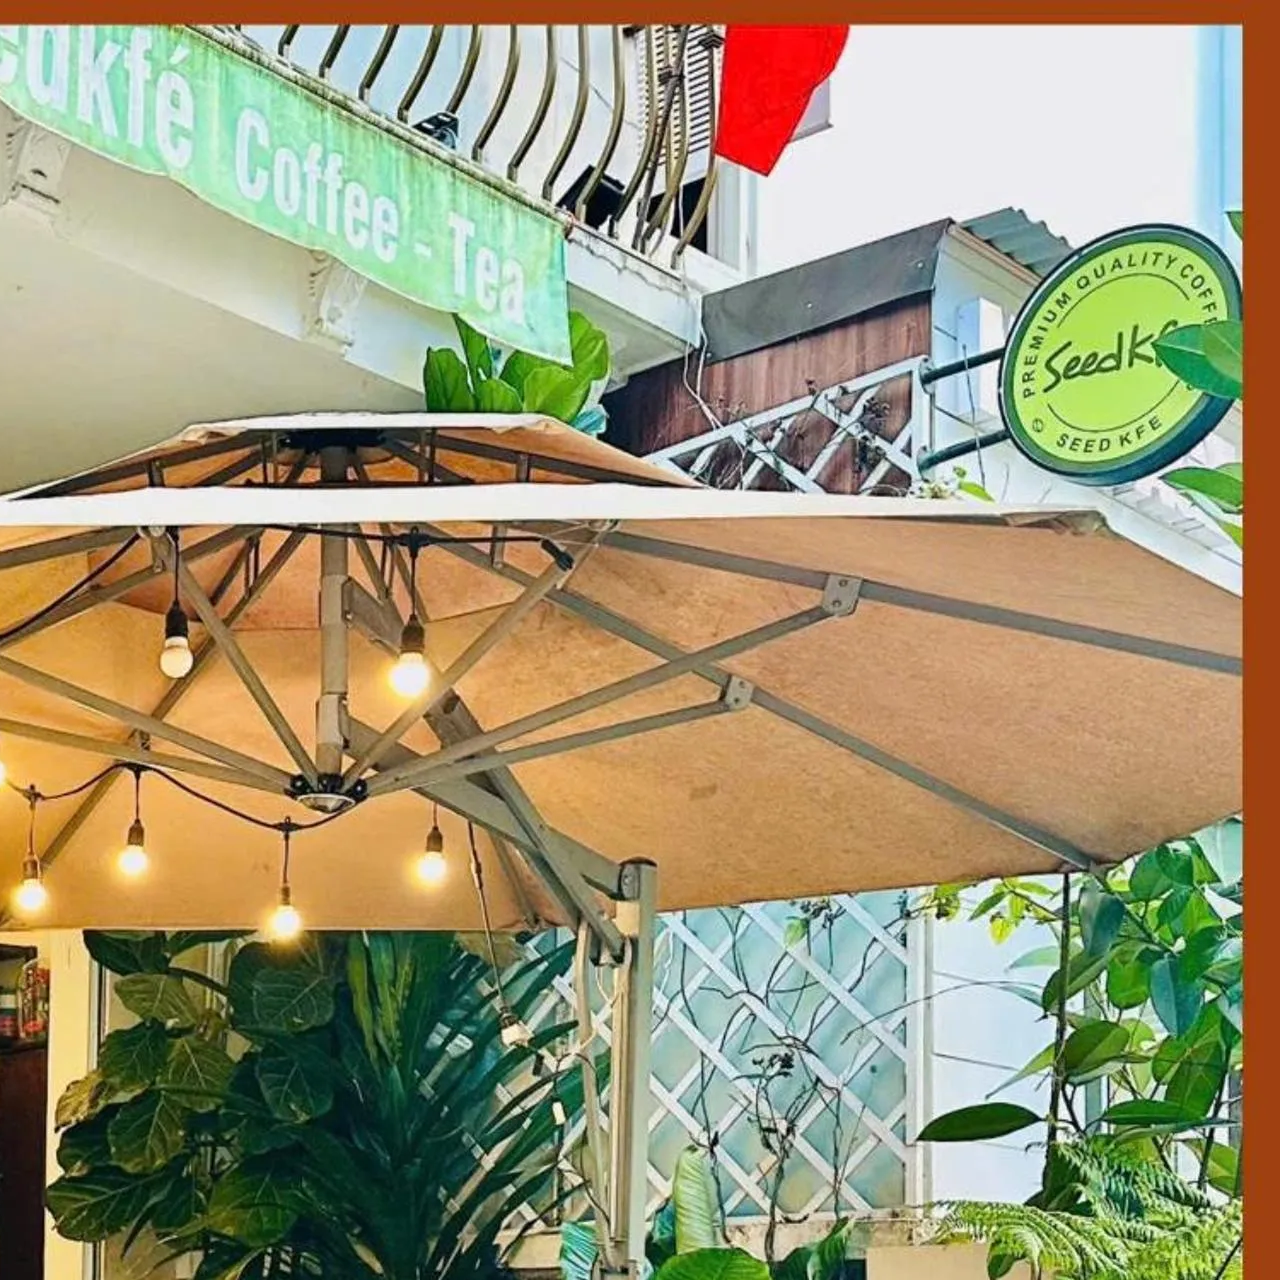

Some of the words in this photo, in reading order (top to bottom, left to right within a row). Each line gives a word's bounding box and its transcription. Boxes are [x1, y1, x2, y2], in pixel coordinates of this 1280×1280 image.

[235, 107, 400, 264] Coffee
[447, 211, 526, 320] Tea
[1022, 292, 1072, 399] PREMIUM
[1076, 251, 1177, 290] QUALITY
[1179, 262, 1219, 326] COFF
[1056, 433, 1111, 453] SEED
[1119, 415, 1163, 448] KFE
